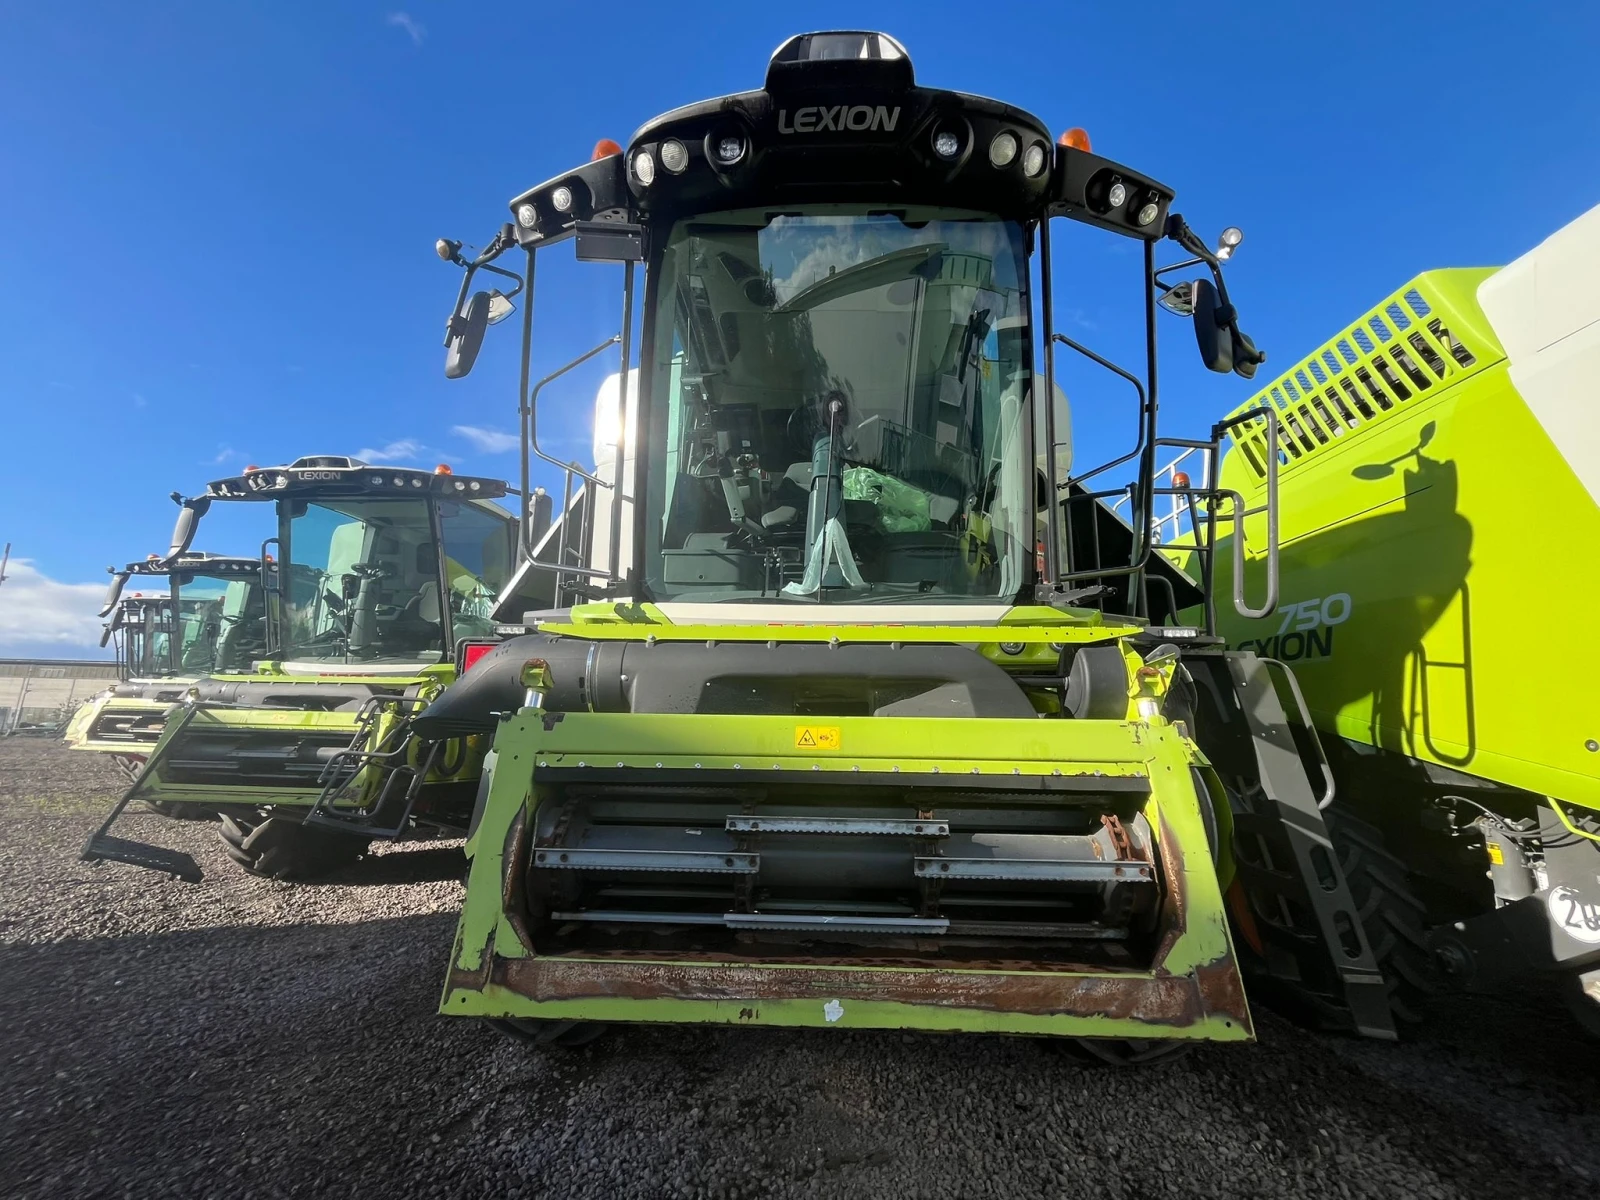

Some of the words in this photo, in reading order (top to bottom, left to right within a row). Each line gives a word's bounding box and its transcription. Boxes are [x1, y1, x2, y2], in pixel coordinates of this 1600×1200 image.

[778, 105, 901, 134] LEXION
[298, 471, 341, 480] LEXION
[1276, 592, 1351, 635] 750
[1225, 626, 1334, 661] XION
